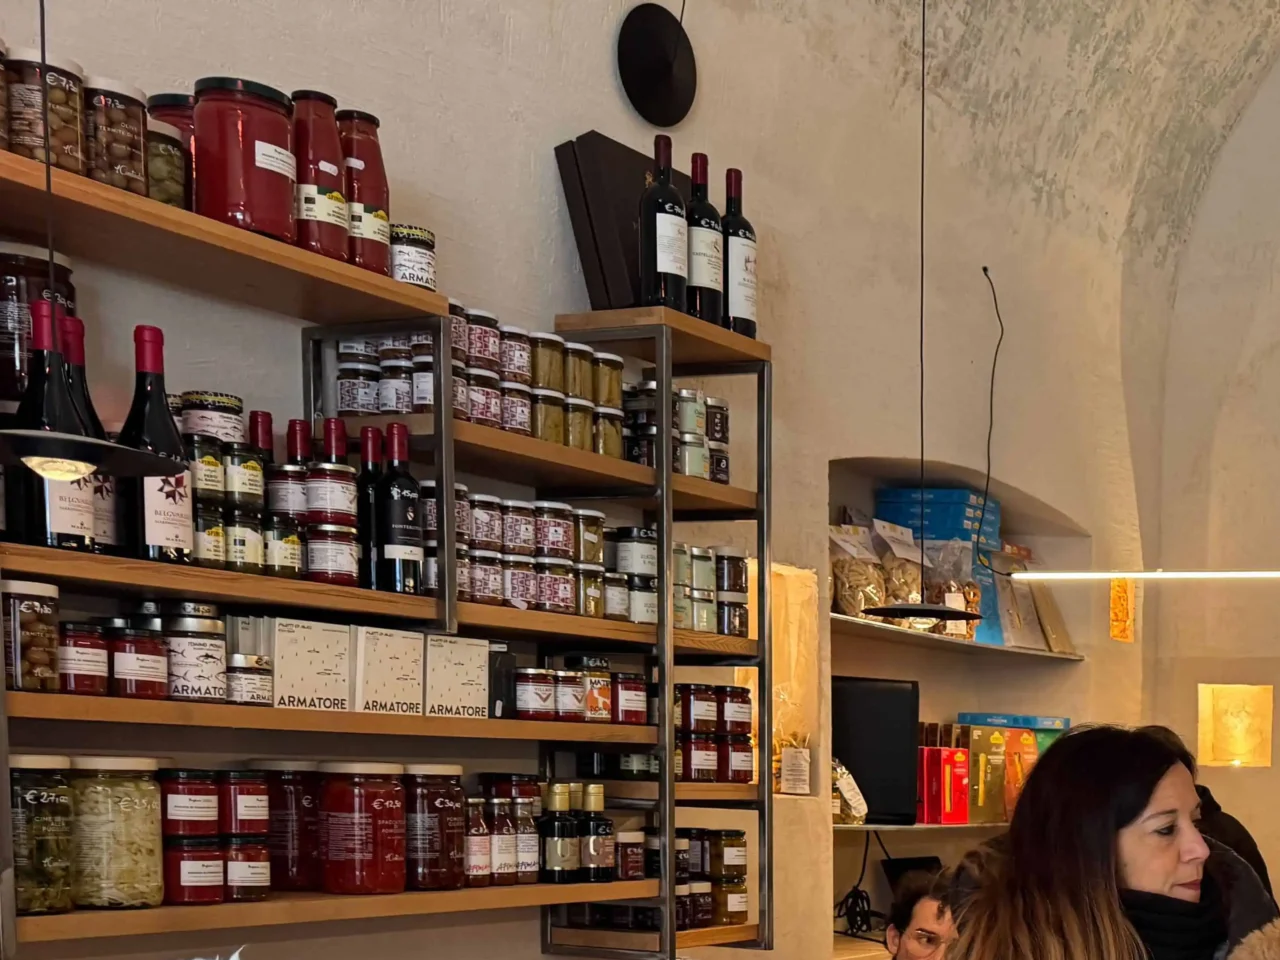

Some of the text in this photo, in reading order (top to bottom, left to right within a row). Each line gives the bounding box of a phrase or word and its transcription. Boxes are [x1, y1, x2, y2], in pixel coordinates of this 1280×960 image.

[277, 694, 347, 710] ARMATORE
[363, 700, 421, 714] ARMATORE
[429, 704, 487, 717] ARMATORE
